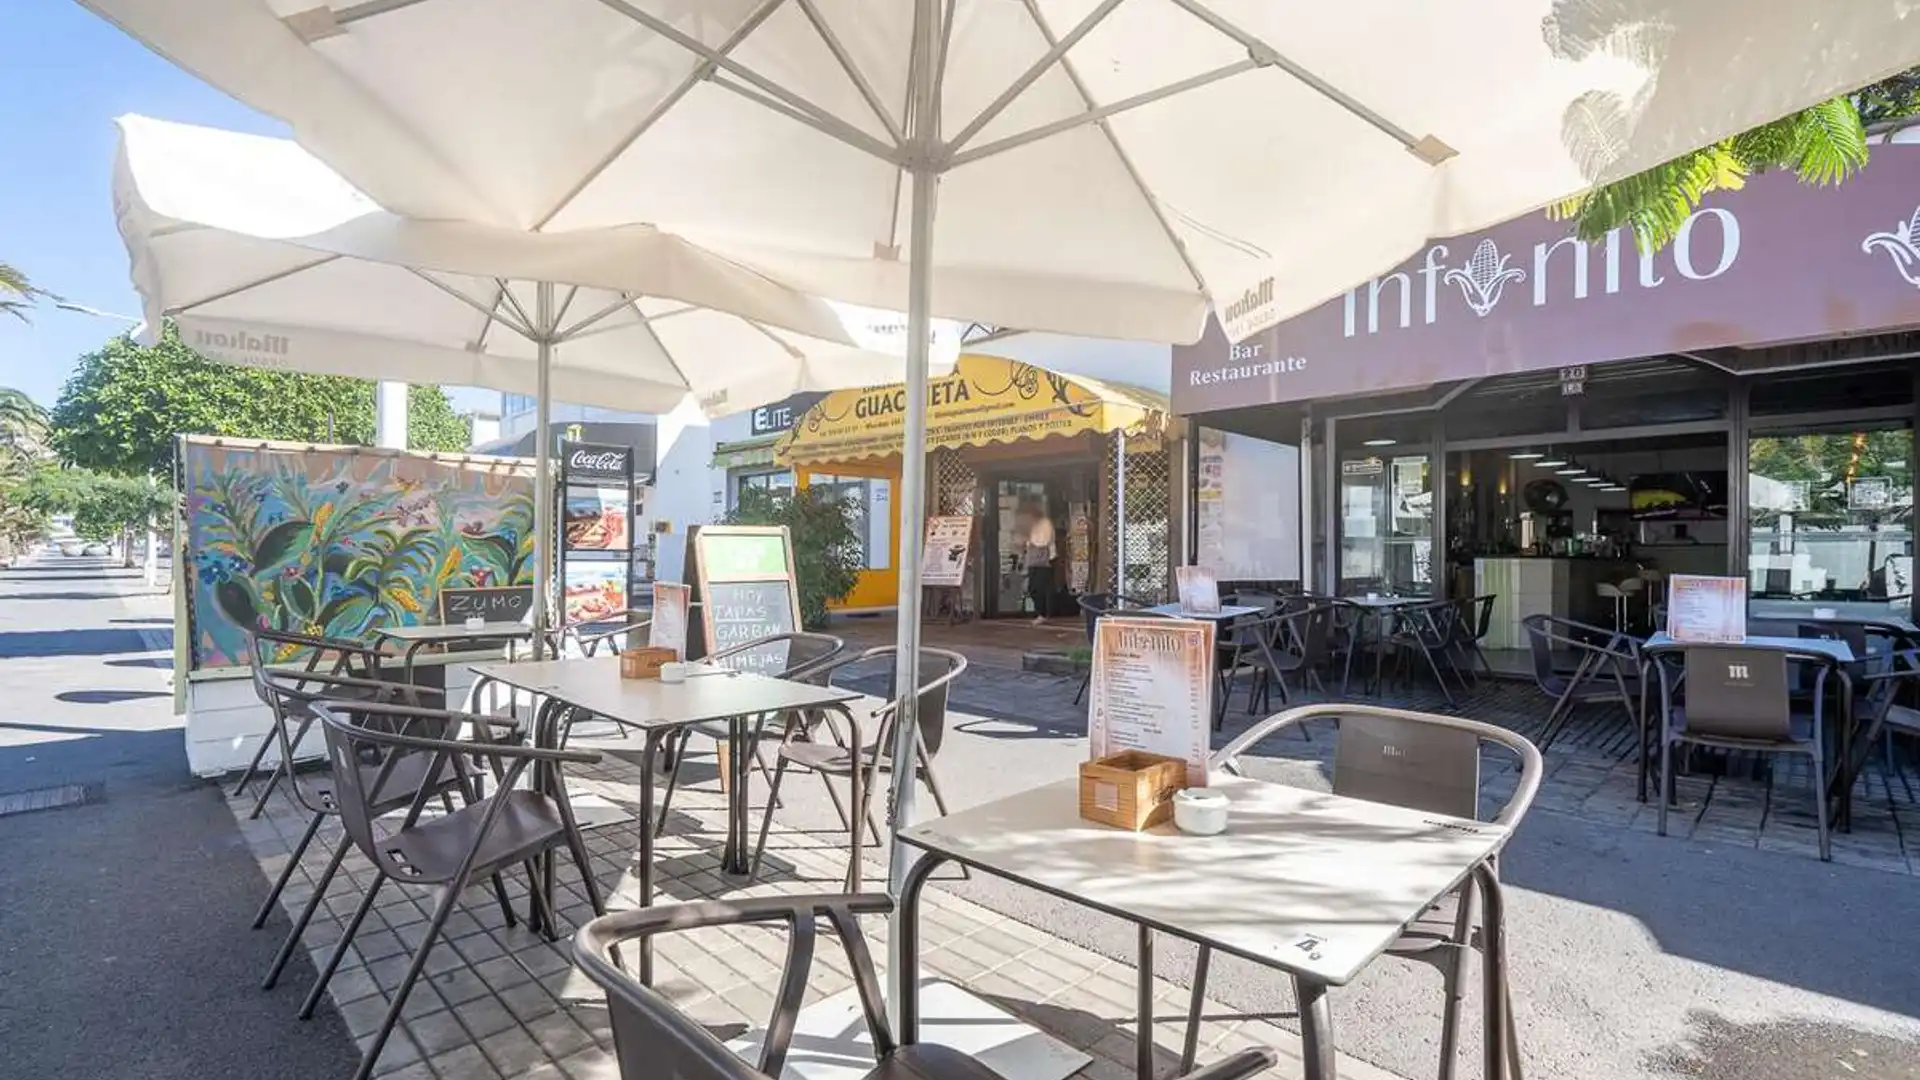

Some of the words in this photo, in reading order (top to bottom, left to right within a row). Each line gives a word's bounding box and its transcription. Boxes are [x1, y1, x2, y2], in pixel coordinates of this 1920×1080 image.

[1229, 345, 1263, 361] Bar
[1190, 356, 1307, 386] Restaurante
[450, 595, 523, 611] ZUMO
